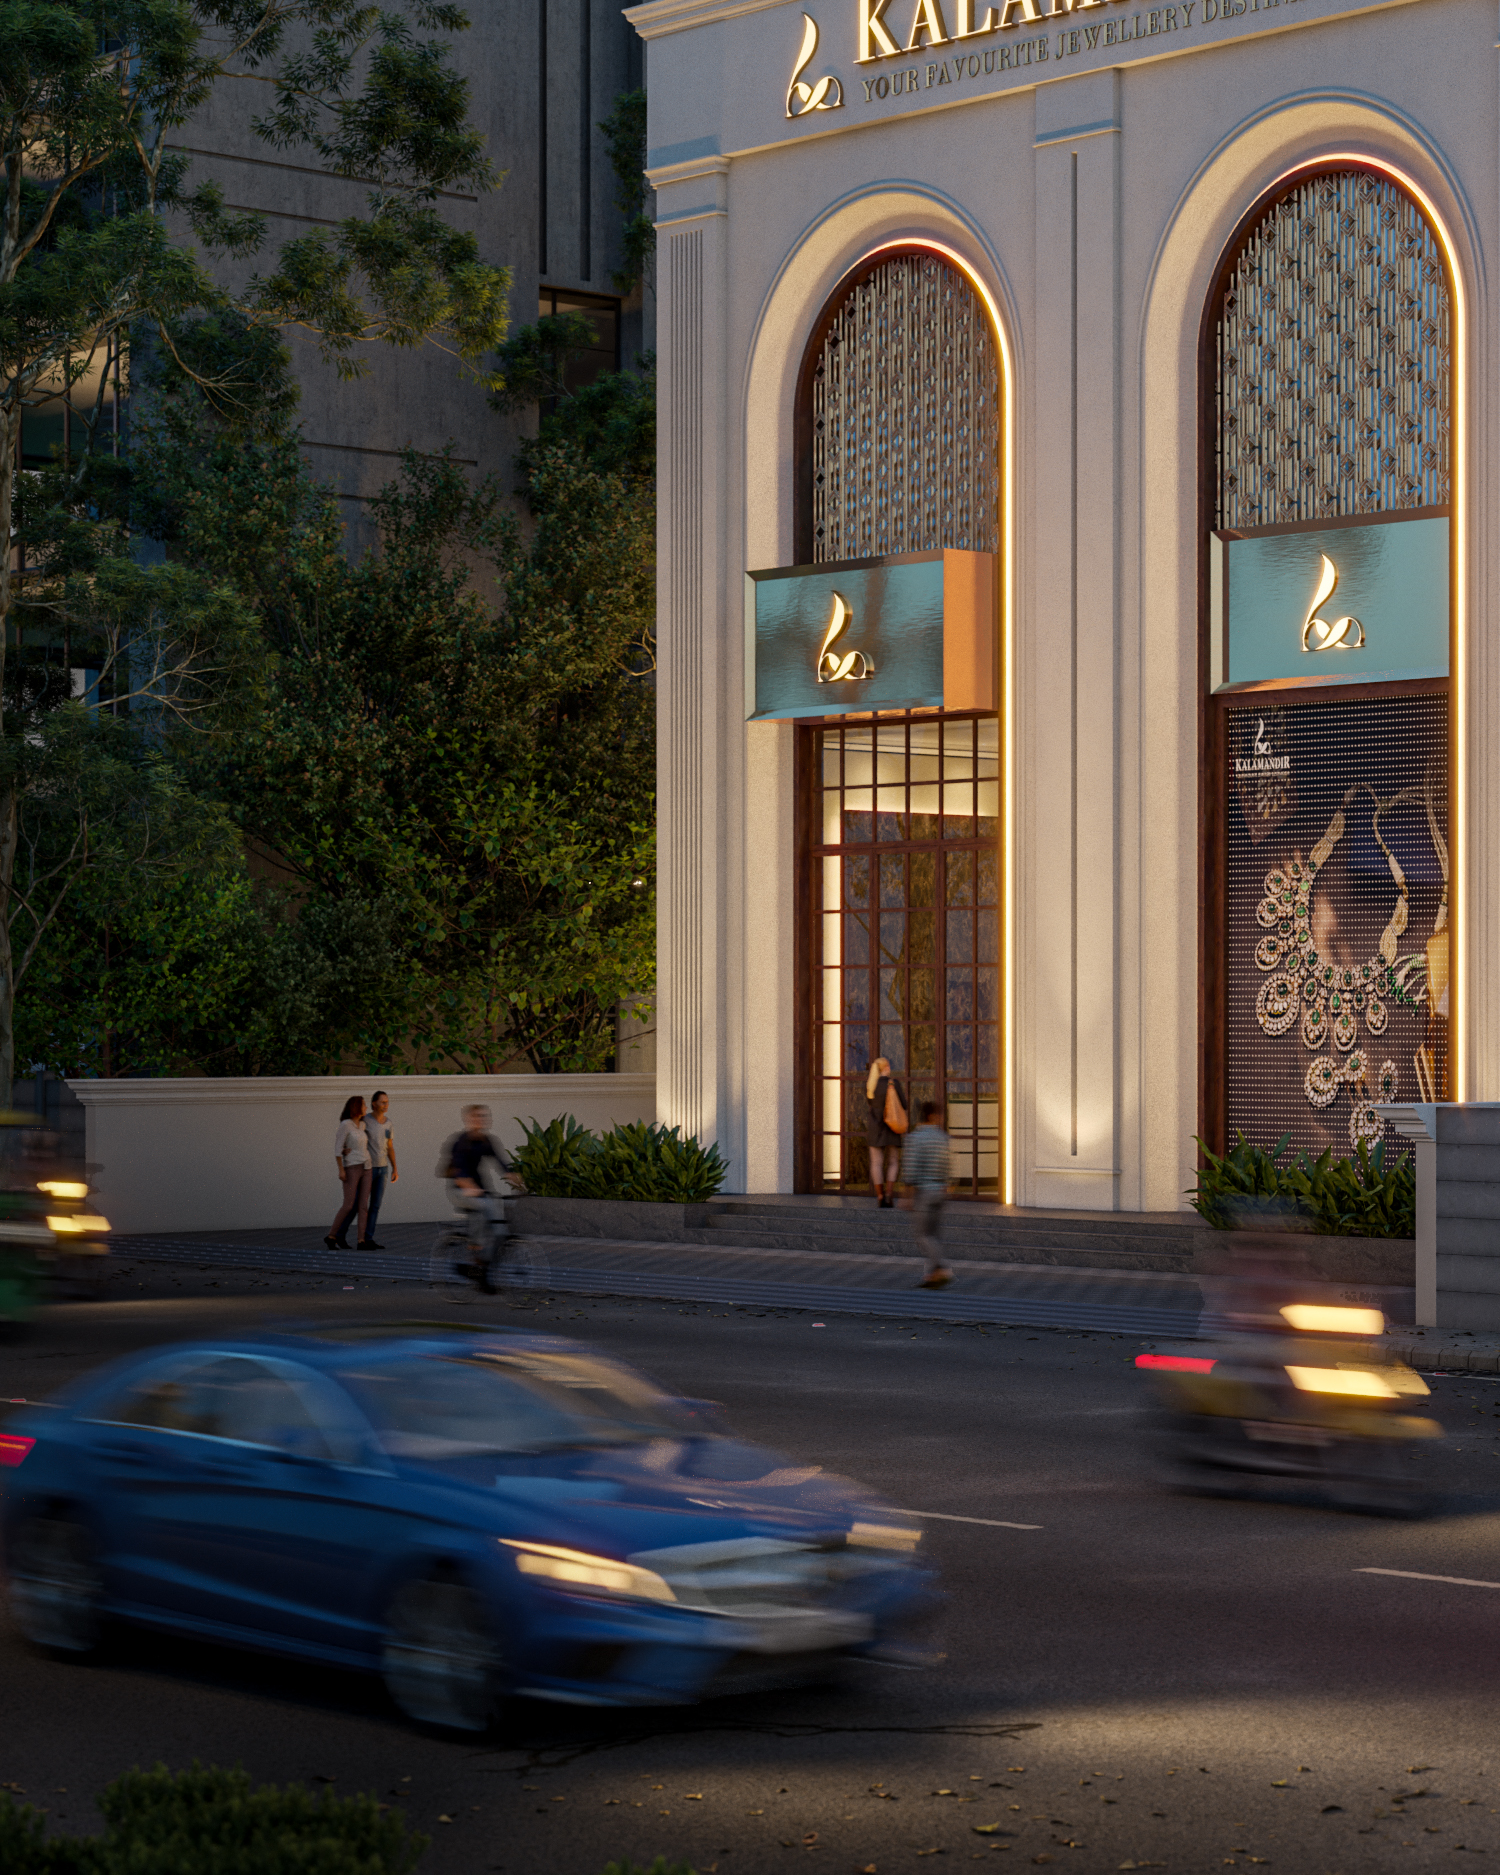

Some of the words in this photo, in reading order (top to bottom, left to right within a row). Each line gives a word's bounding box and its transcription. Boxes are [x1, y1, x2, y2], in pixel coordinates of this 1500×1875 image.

[860, 68, 920, 103] YOUR
[924, 37, 1049, 90] FAVOURITE
[1053, 1, 1196, 61] JEWELLERY
[1234, 755, 1291, 772] KALAMANDIR
